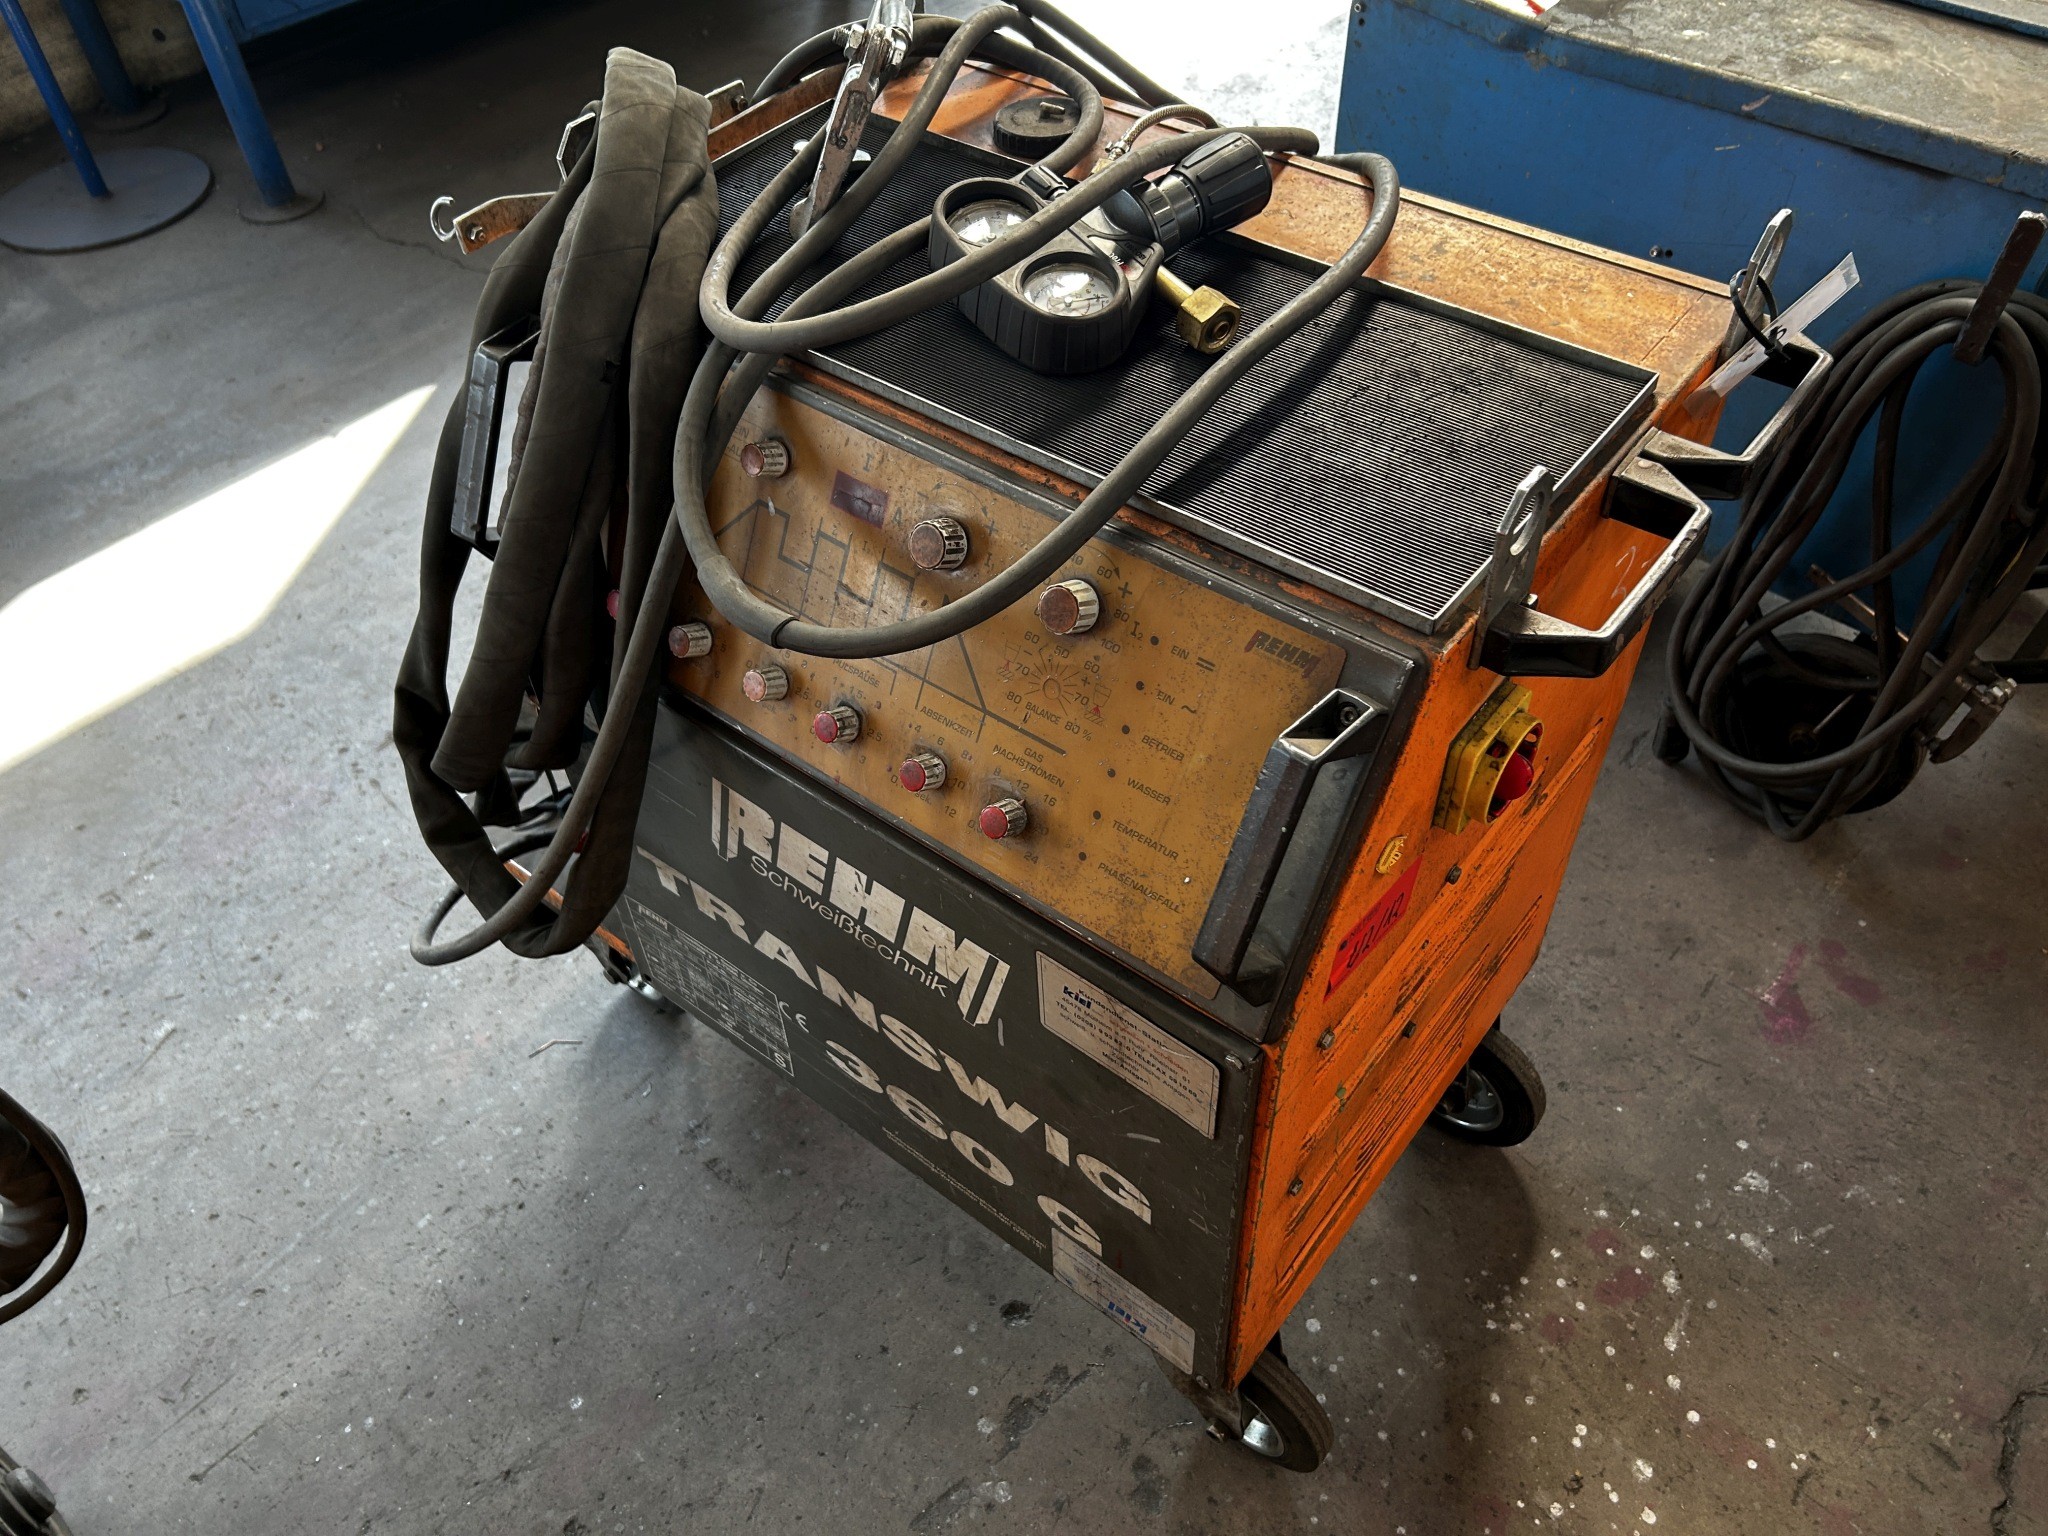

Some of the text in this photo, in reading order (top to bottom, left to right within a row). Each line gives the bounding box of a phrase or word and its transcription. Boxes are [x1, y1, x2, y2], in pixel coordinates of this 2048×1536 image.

[1096, 565, 1113, 580] 60
[1114, 609, 1130, 623] 80
[1024, 631, 1040, 645] 60
[1054, 646, 1070, 660] 50
[1101, 638, 1121, 654] 100
[1171, 645, 1190, 661] EIN
[1245, 629, 1321, 679] REHM
[1015, 662, 1030, 677] 70
[1083, 660, 1100, 675] 60
[1006, 691, 1022, 705] 80
[1073, 692, 1090, 707] 70
[1156, 690, 1175, 706] EIN
[1024, 701, 1062, 726] BALANCE
[914, 724, 922, 734] 4
[920, 706, 975, 739] ABSENKZEIT
[1064, 720, 1081, 735] 80
[937, 736, 945, 746] 6
[1141, 734, 1185, 762] BETRIEB
[859, 756, 867, 764] 3
[1023, 747, 1045, 763] GAS
[952, 777, 966, 790] 10
[1016, 779, 1030, 793] 12
[1127, 777, 1172, 806] WASSER
[1043, 794, 1057, 807] 16
[944, 805, 957, 818] 12
[1111, 819, 1180, 861] TEMPERATUR
[1023, 851, 1040, 865] 24
[1098, 862, 1183, 914] PHASENAUSFALL
[711, 776, 1011, 1027] REHM
[750, 854, 951, 999] Schweißtechnik
[636, 845, 1153, 1225] TRANSWIG
[774, 1052, 787, 1069] S
[1134, 1050, 1166, 1076] TELEFAX
[824, 1039, 1015, 1187] 360
[1037, 1194, 1103, 1258] G
